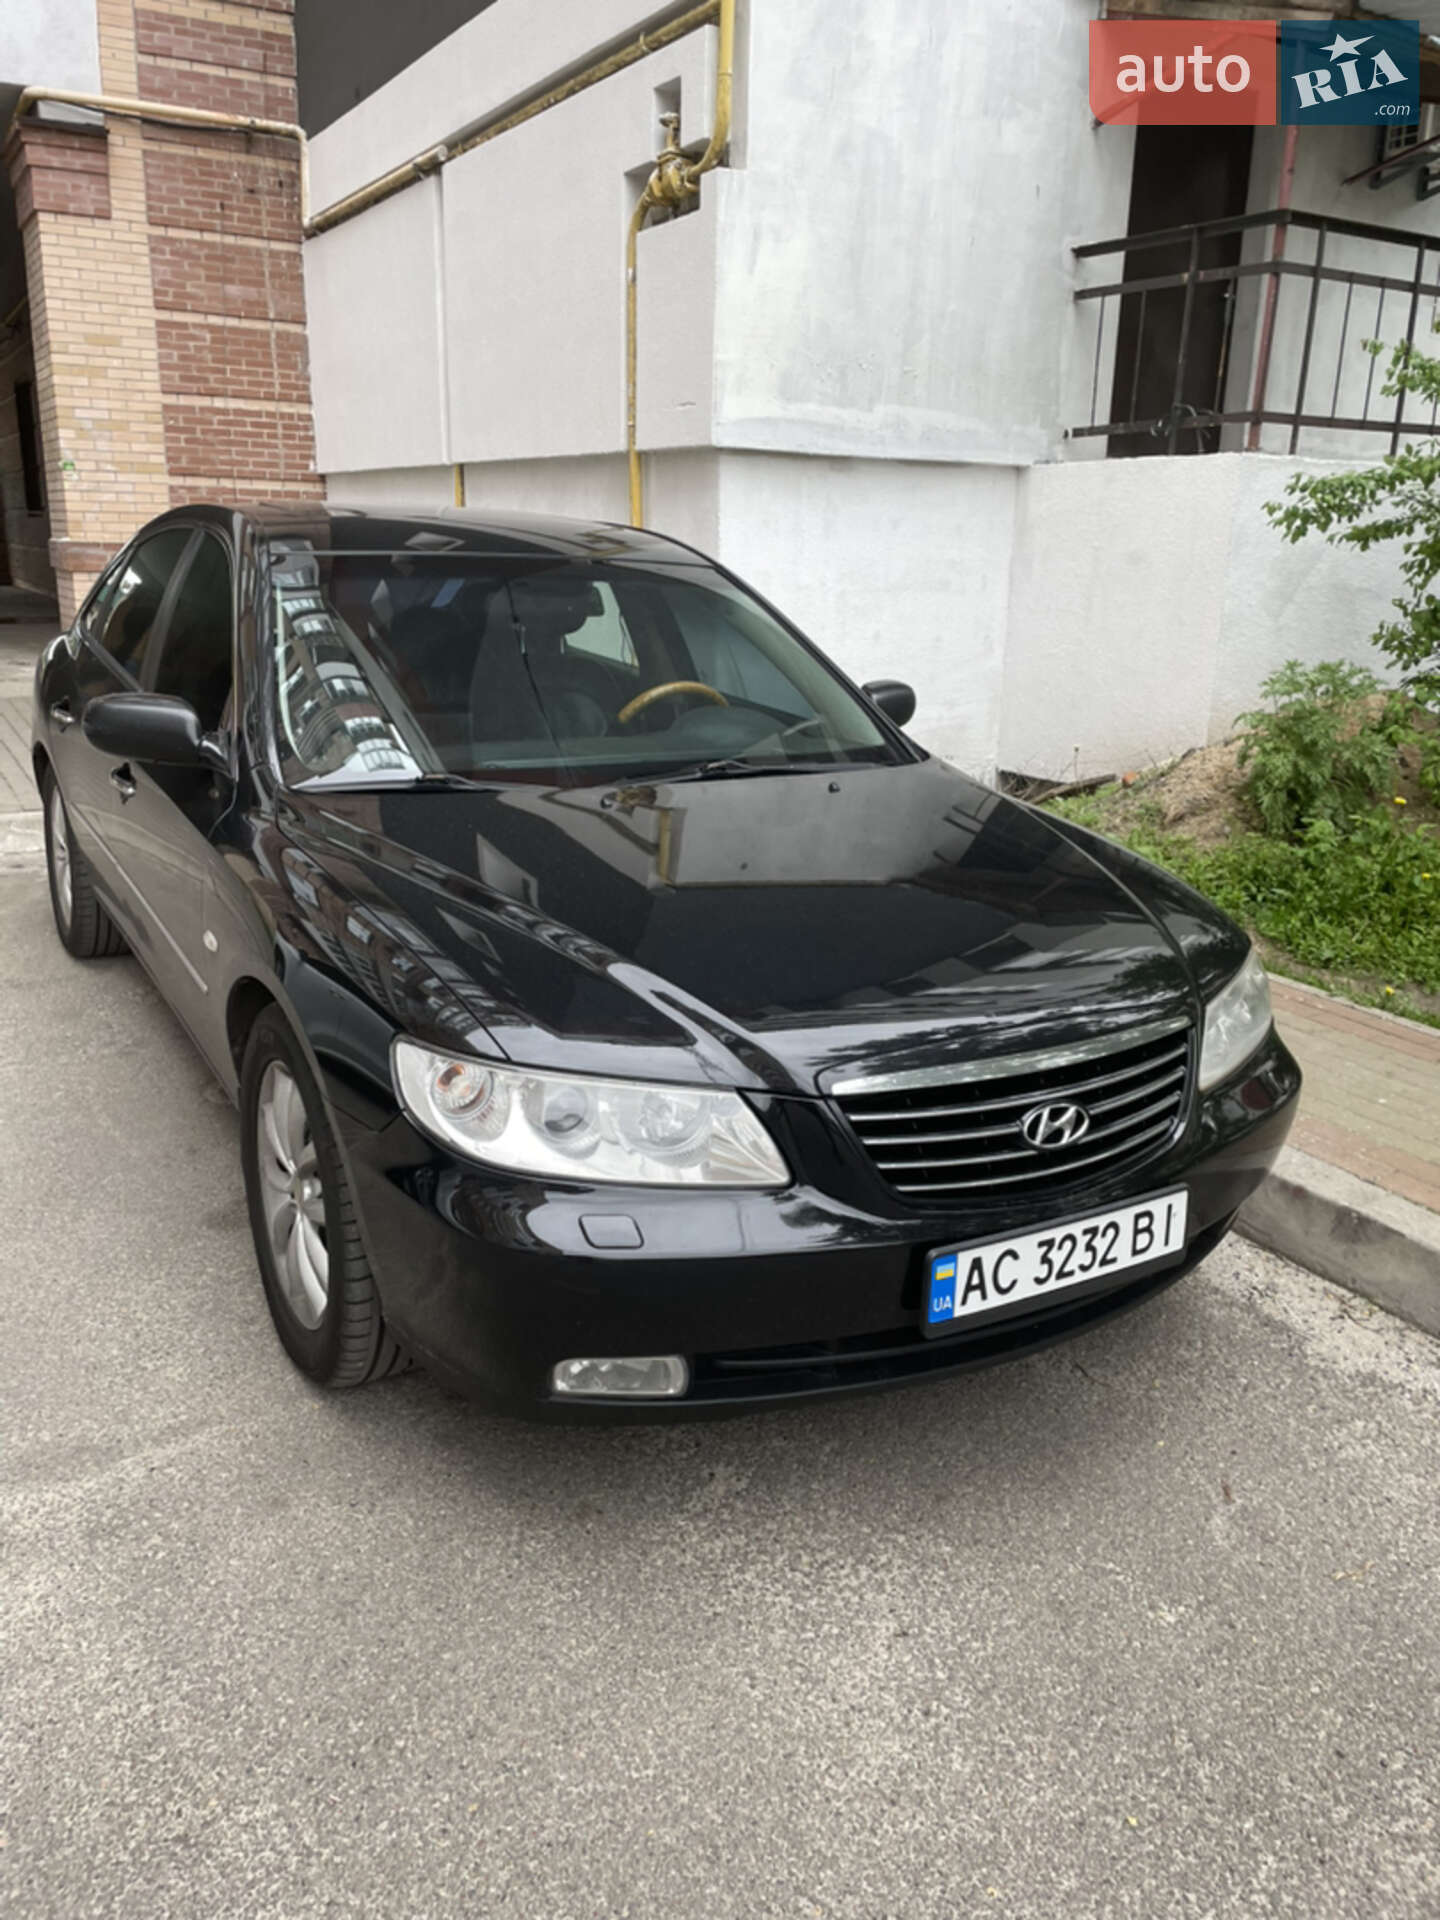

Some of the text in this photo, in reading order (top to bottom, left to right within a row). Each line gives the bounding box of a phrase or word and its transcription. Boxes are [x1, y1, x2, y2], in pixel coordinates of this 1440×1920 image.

[960, 1203, 1173, 1306] AC 3232 BI
[933, 1295, 952, 1312] UA
